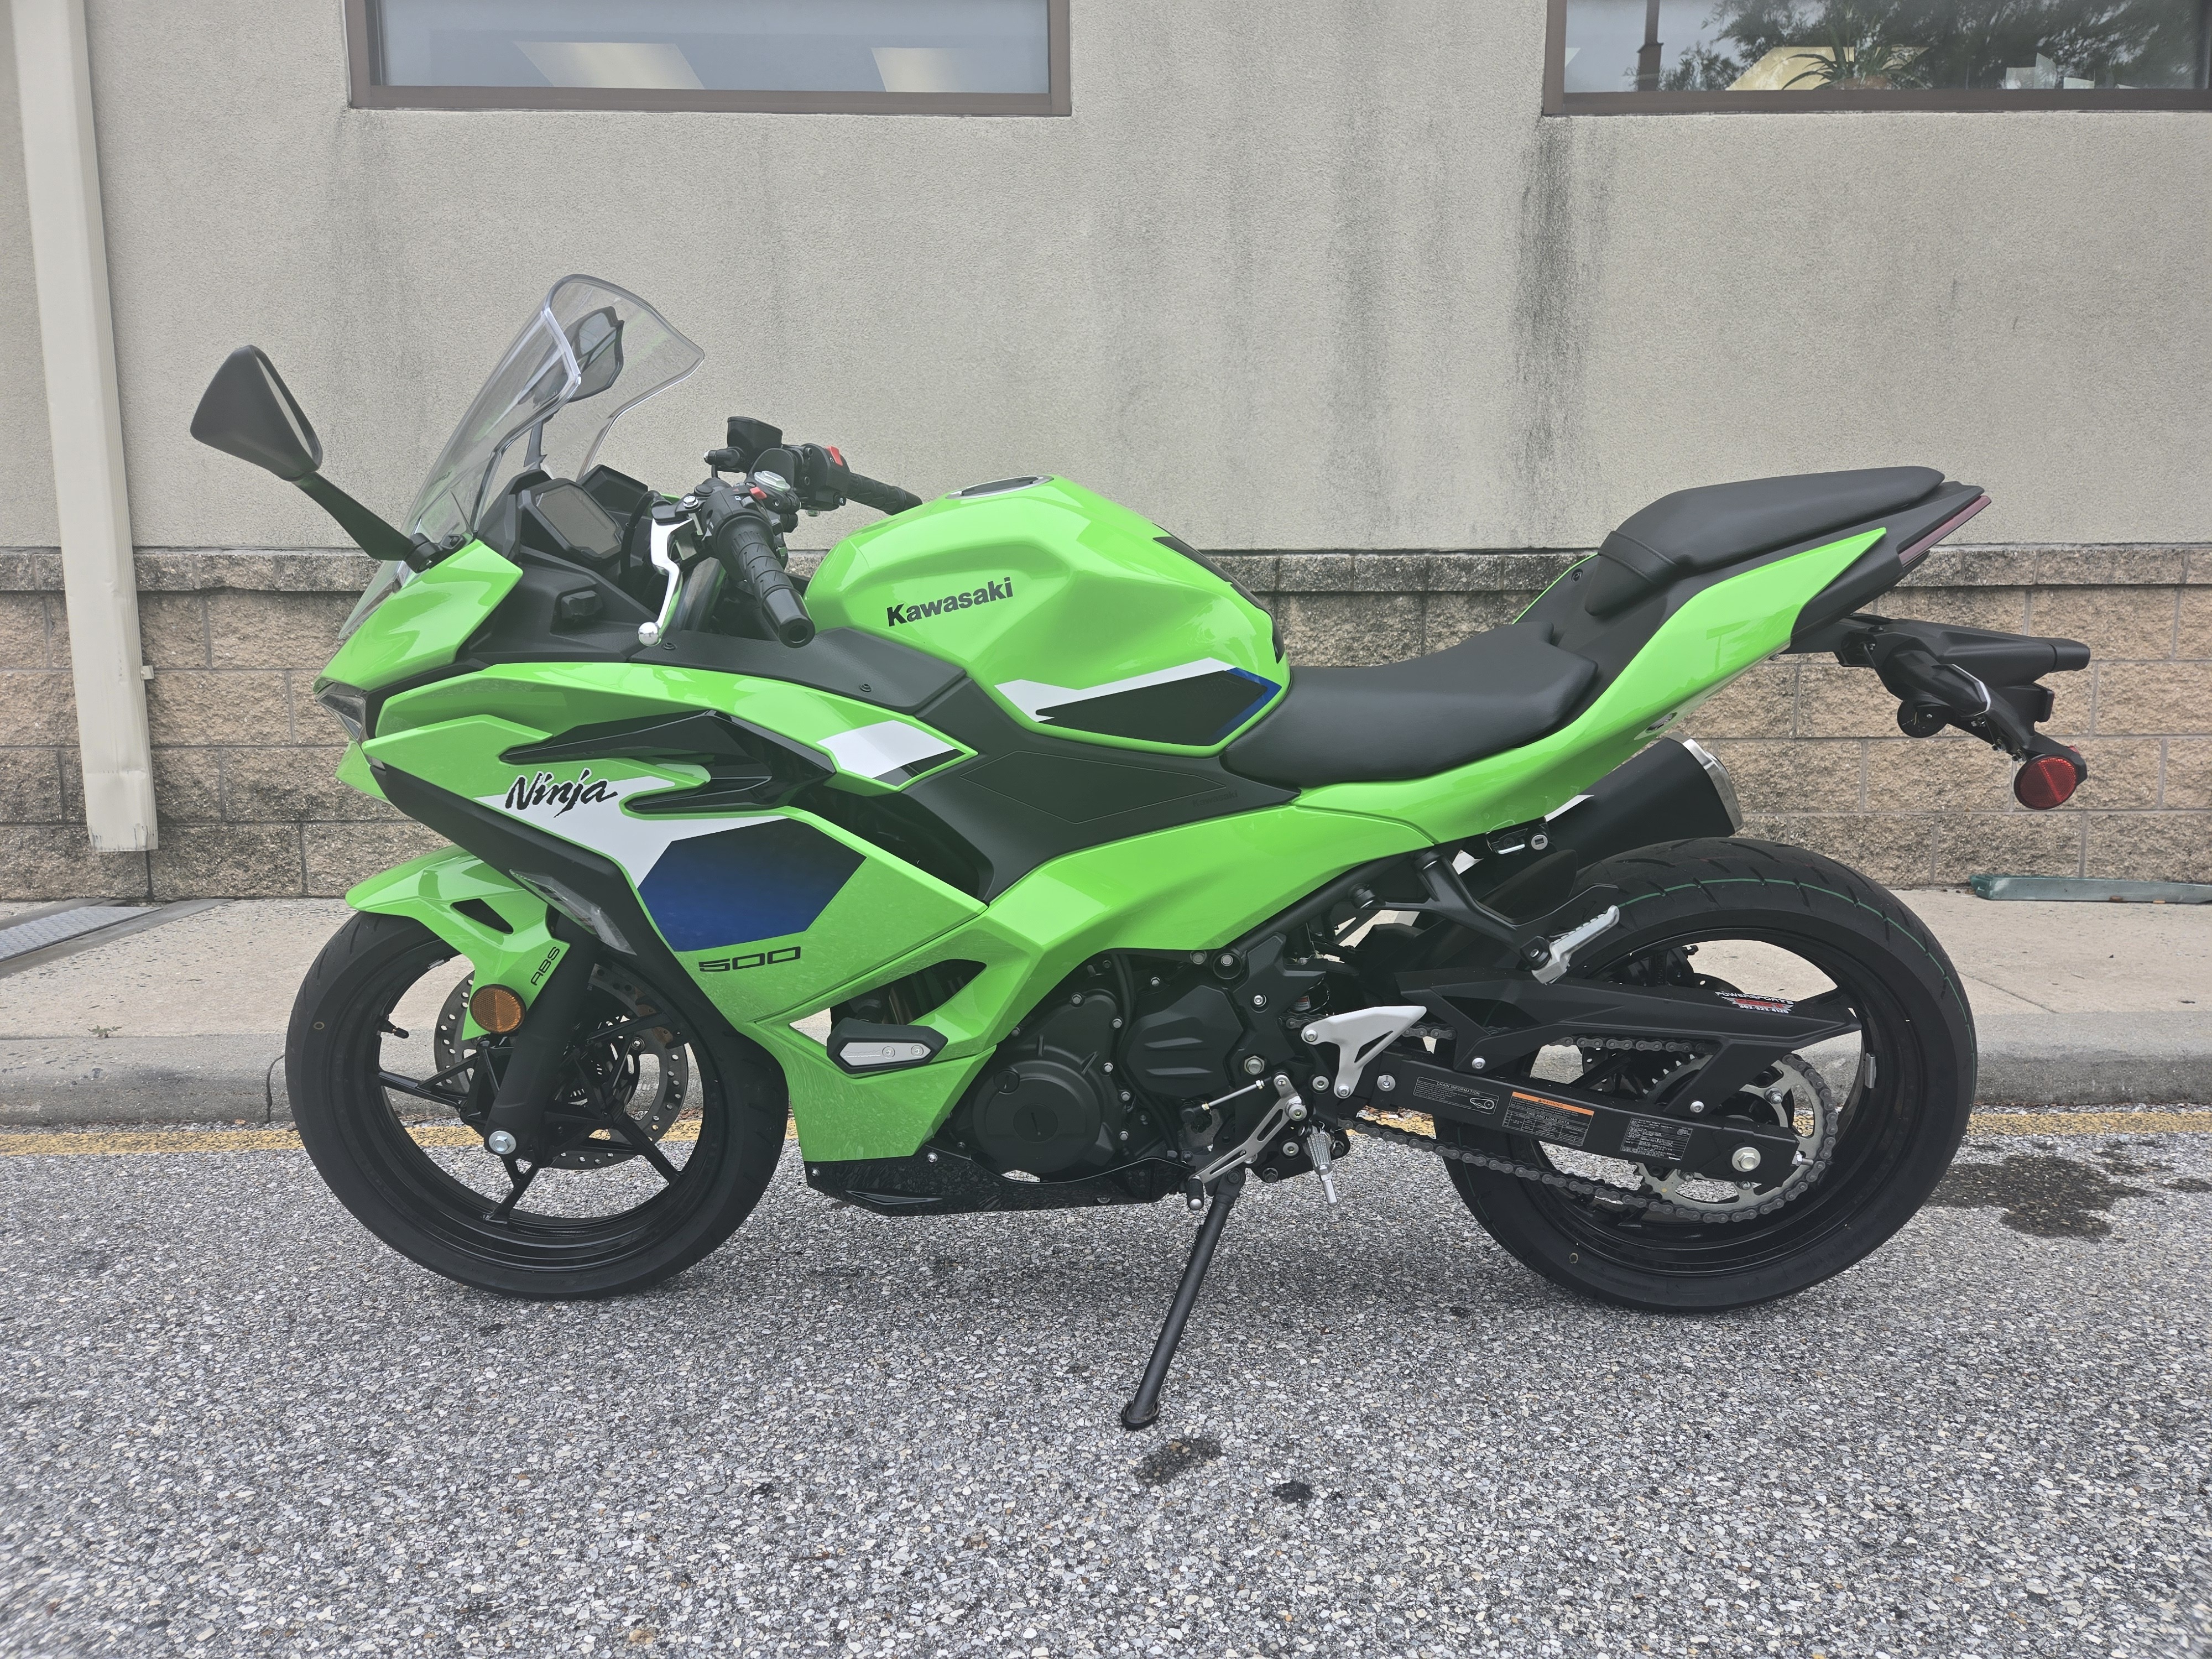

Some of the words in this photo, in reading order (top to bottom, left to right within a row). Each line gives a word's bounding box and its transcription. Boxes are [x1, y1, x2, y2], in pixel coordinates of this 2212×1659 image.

[886, 577, 1013, 627] Kawasaki
[505, 769, 618, 818] Ninja
[1192, 790, 1238, 807] Kawasaki
[530, 946, 560, 986] ABS
[698, 946, 801, 972] 500
[1715, 992, 1794, 1005] POWERSPORTS
[1451, 1086, 1480, 1095] INFORMATION
